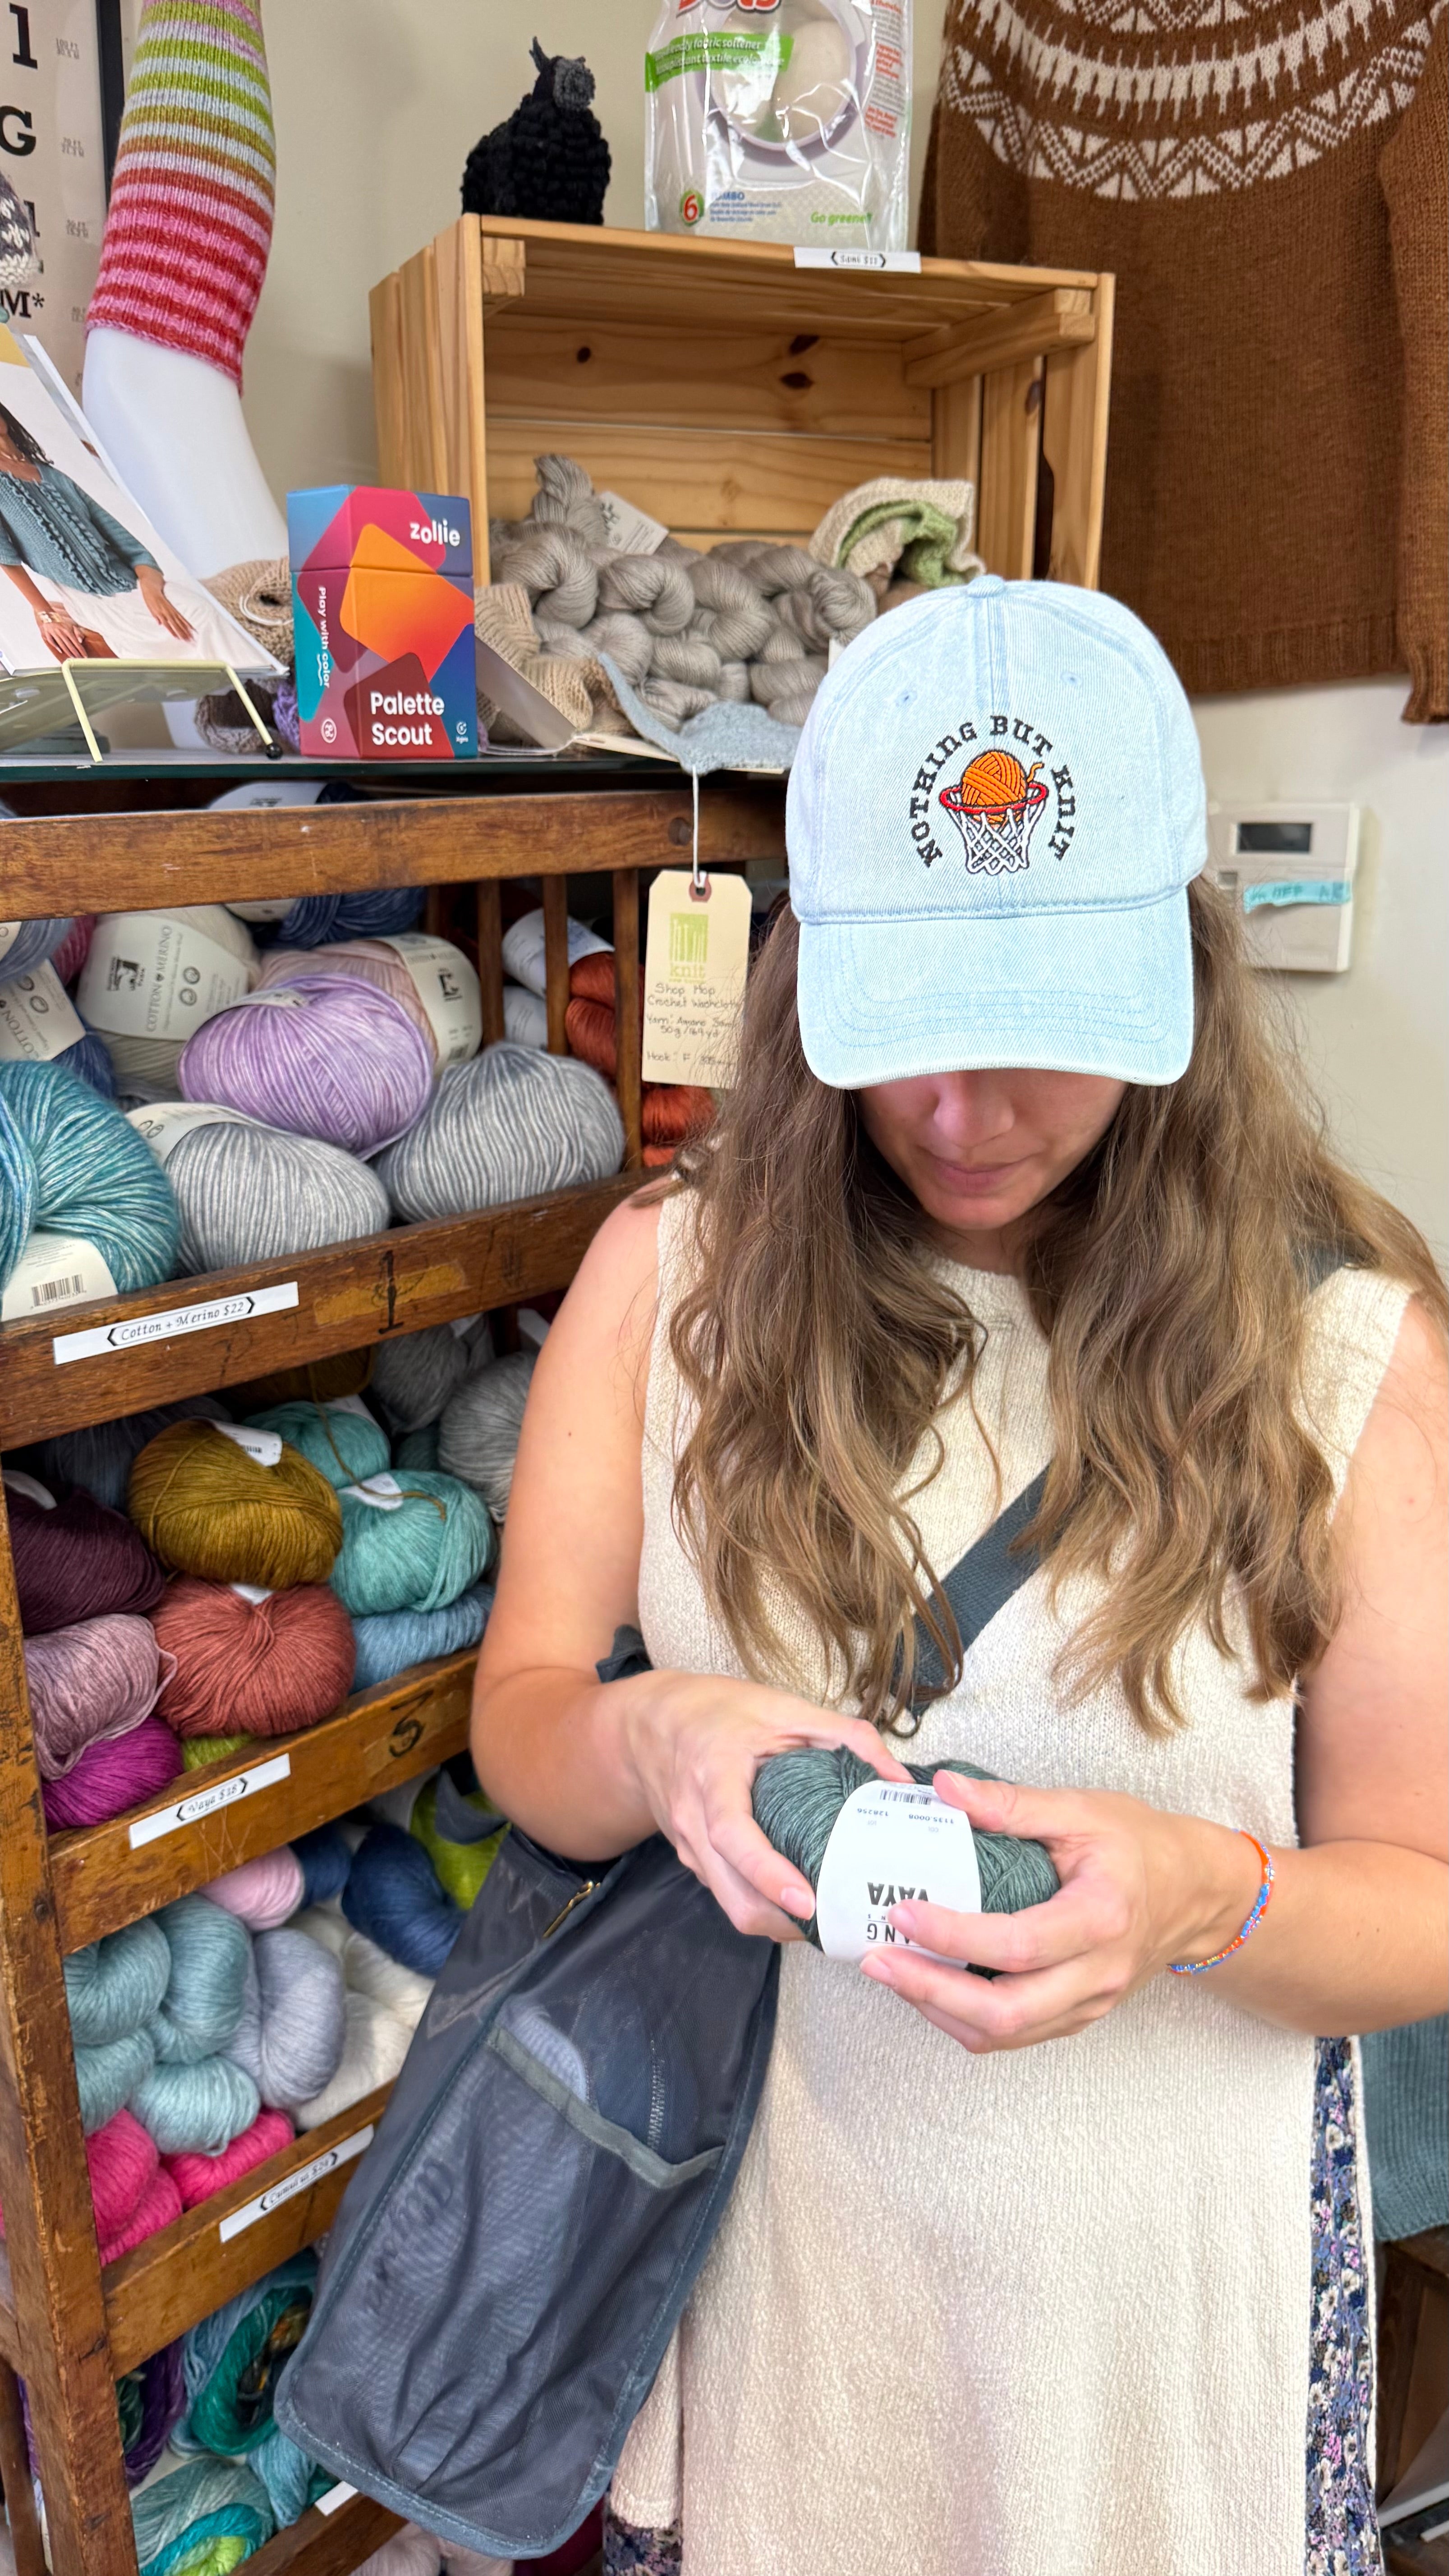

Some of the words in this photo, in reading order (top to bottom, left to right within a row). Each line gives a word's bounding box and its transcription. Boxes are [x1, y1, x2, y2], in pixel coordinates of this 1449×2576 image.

[683, 194, 699, 222] 6
[811, 210, 826, 223] Go
[409, 517, 460, 547] zollie
[317, 586, 327, 617] Play
[320, 620, 330, 650] with
[322, 653, 331, 689] color
[370, 690, 445, 715] Palette
[372, 722, 433, 745] Scout
[909, 722, 977, 868] NOTHING
[989, 715, 1053, 757] BUT
[1049, 764, 1076, 861] KNIT
[647, 994, 687, 1007] Crochet
[655, 982, 685, 997] Shop
[693, 984, 716, 999] Hop
[121, 1322, 162, 1342] Cotton
[165, 1321, 174, 1330] +
[175, 1308, 220, 1328] Merino
[224, 1302, 244, 1317] $22
[187, 1794, 216, 1814] Vaya
[857, 1808, 888, 1817] 128256
[909, 1814, 954, 1824] 1135.0008
[867, 1881, 929, 1907] VAYA
